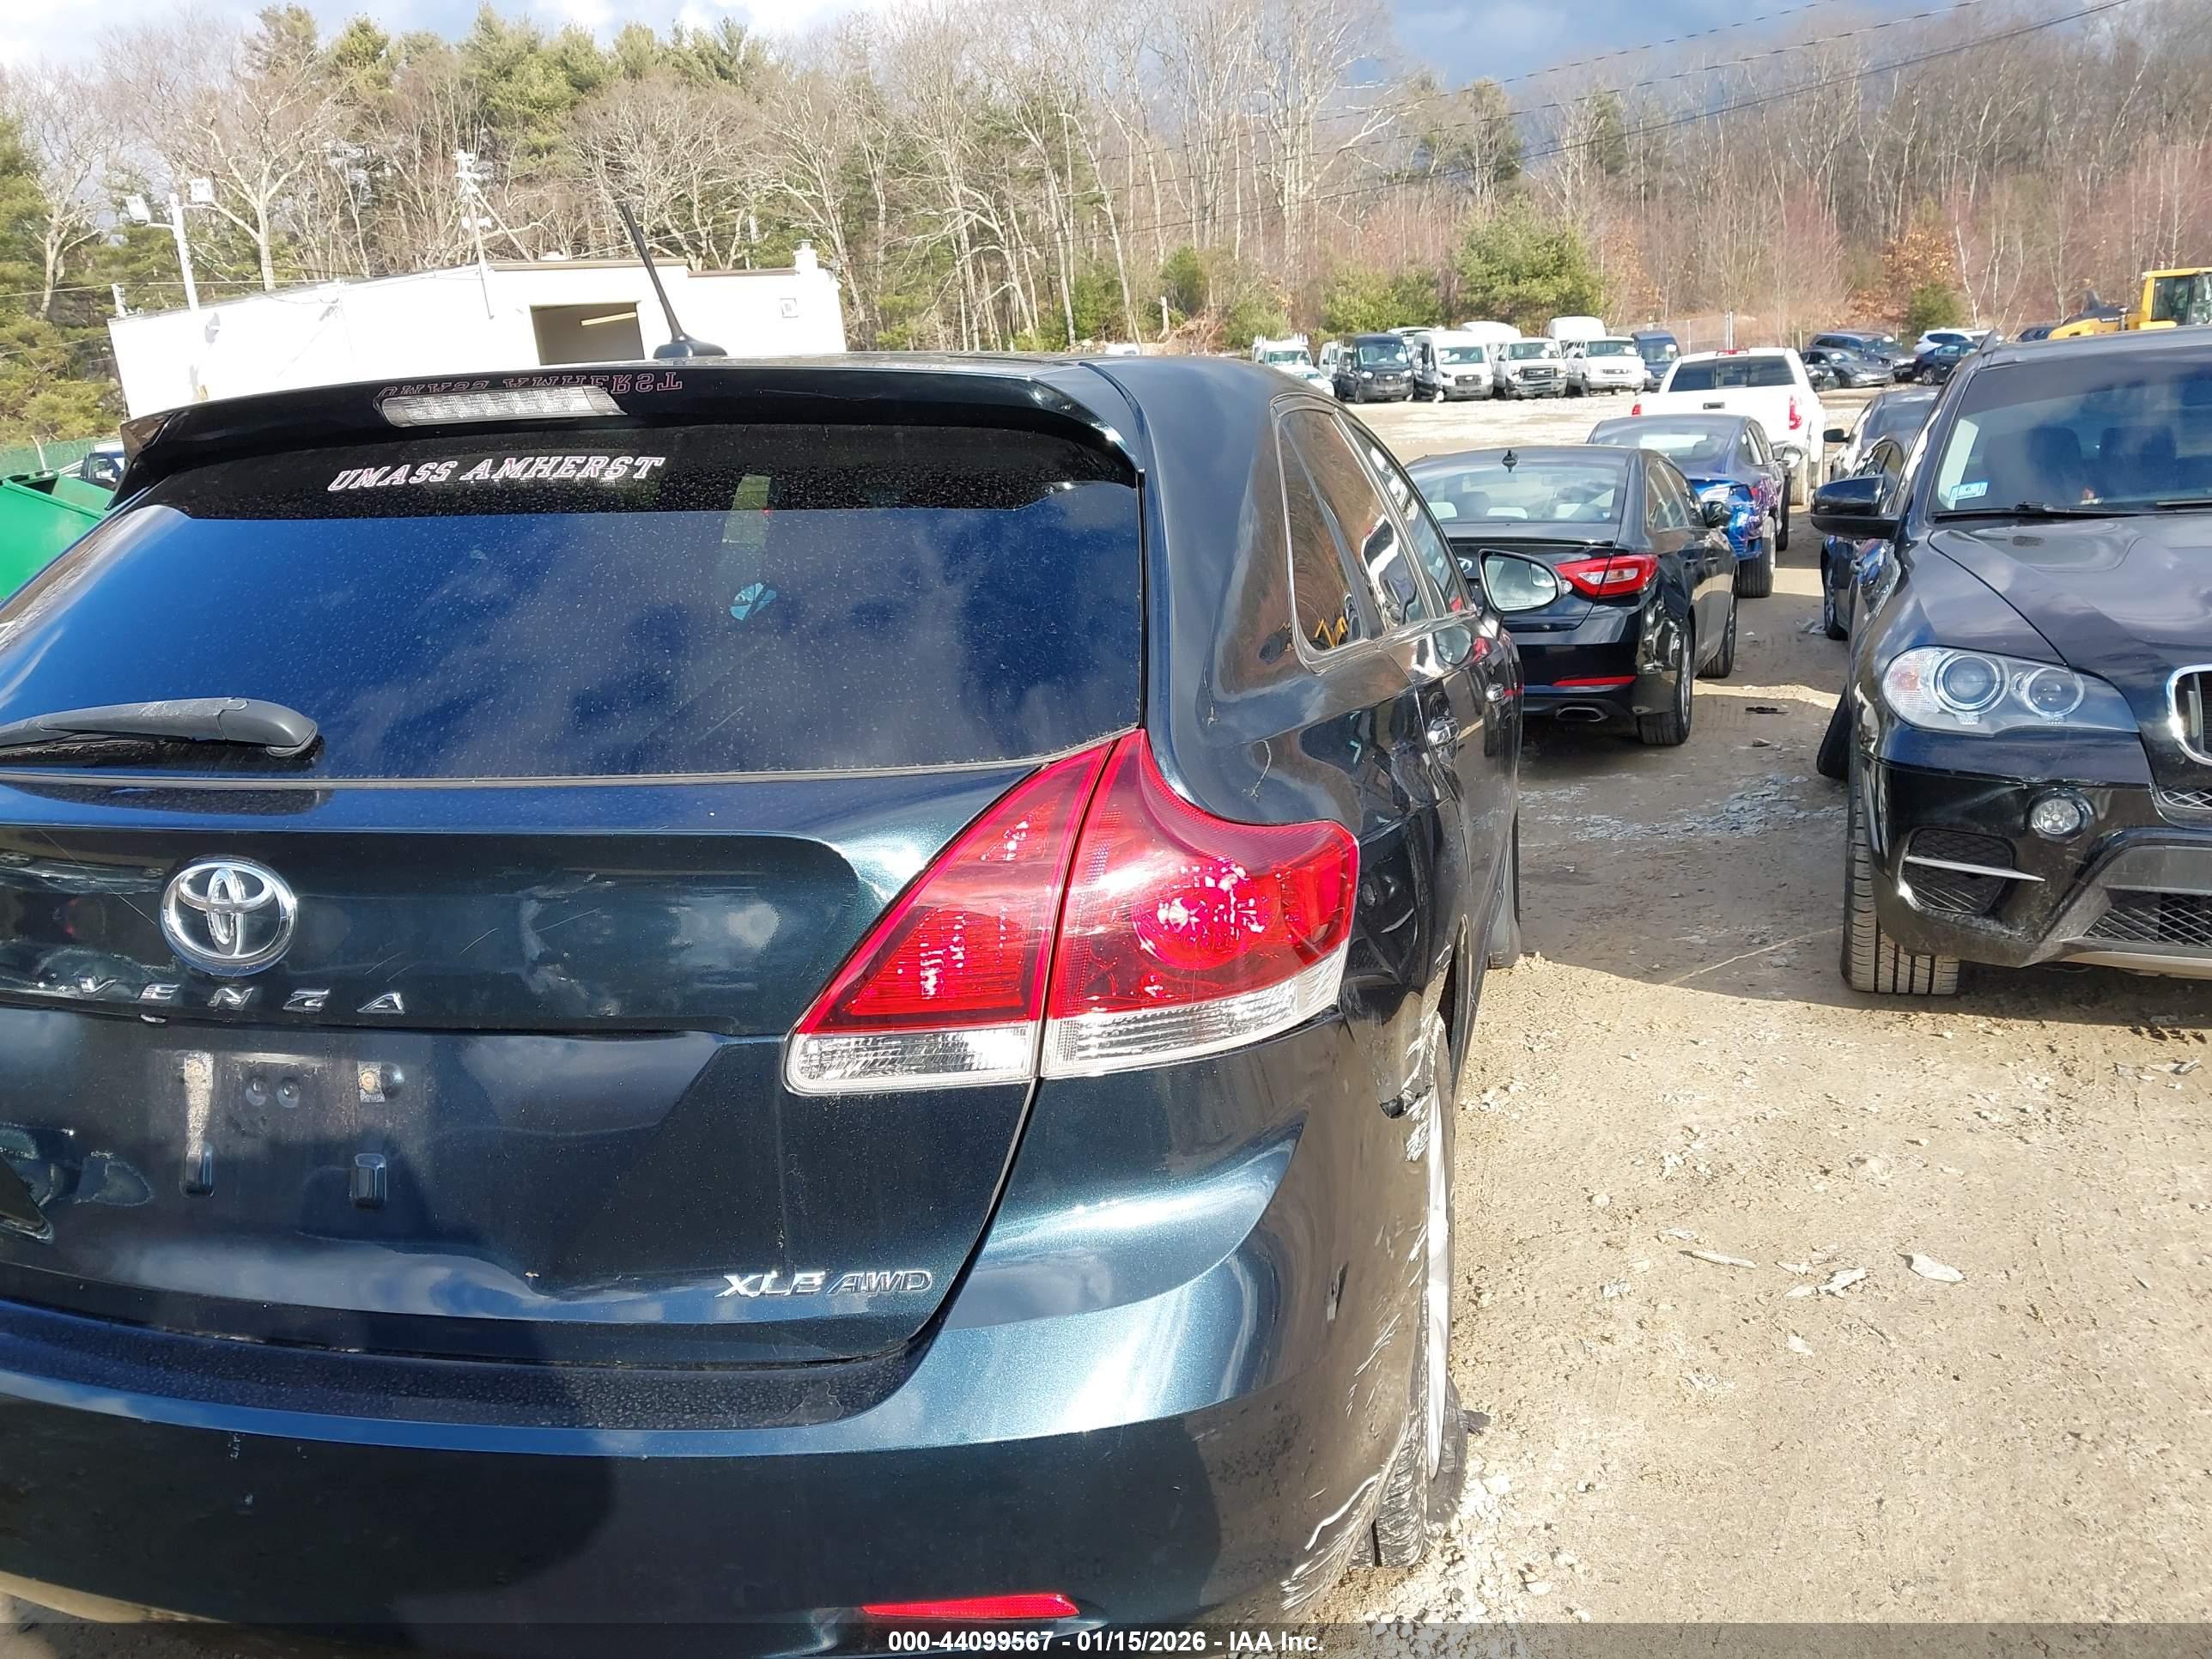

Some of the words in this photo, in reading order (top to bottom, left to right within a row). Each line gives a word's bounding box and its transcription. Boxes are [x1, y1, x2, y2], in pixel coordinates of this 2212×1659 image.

[328, 460, 459, 491] UMASS
[459, 456, 665, 480] AMHERST
[79, 975, 405, 1014] VENZA
[714, 1270, 826, 1298] XLE
[826, 1270, 933, 1295] AWD
